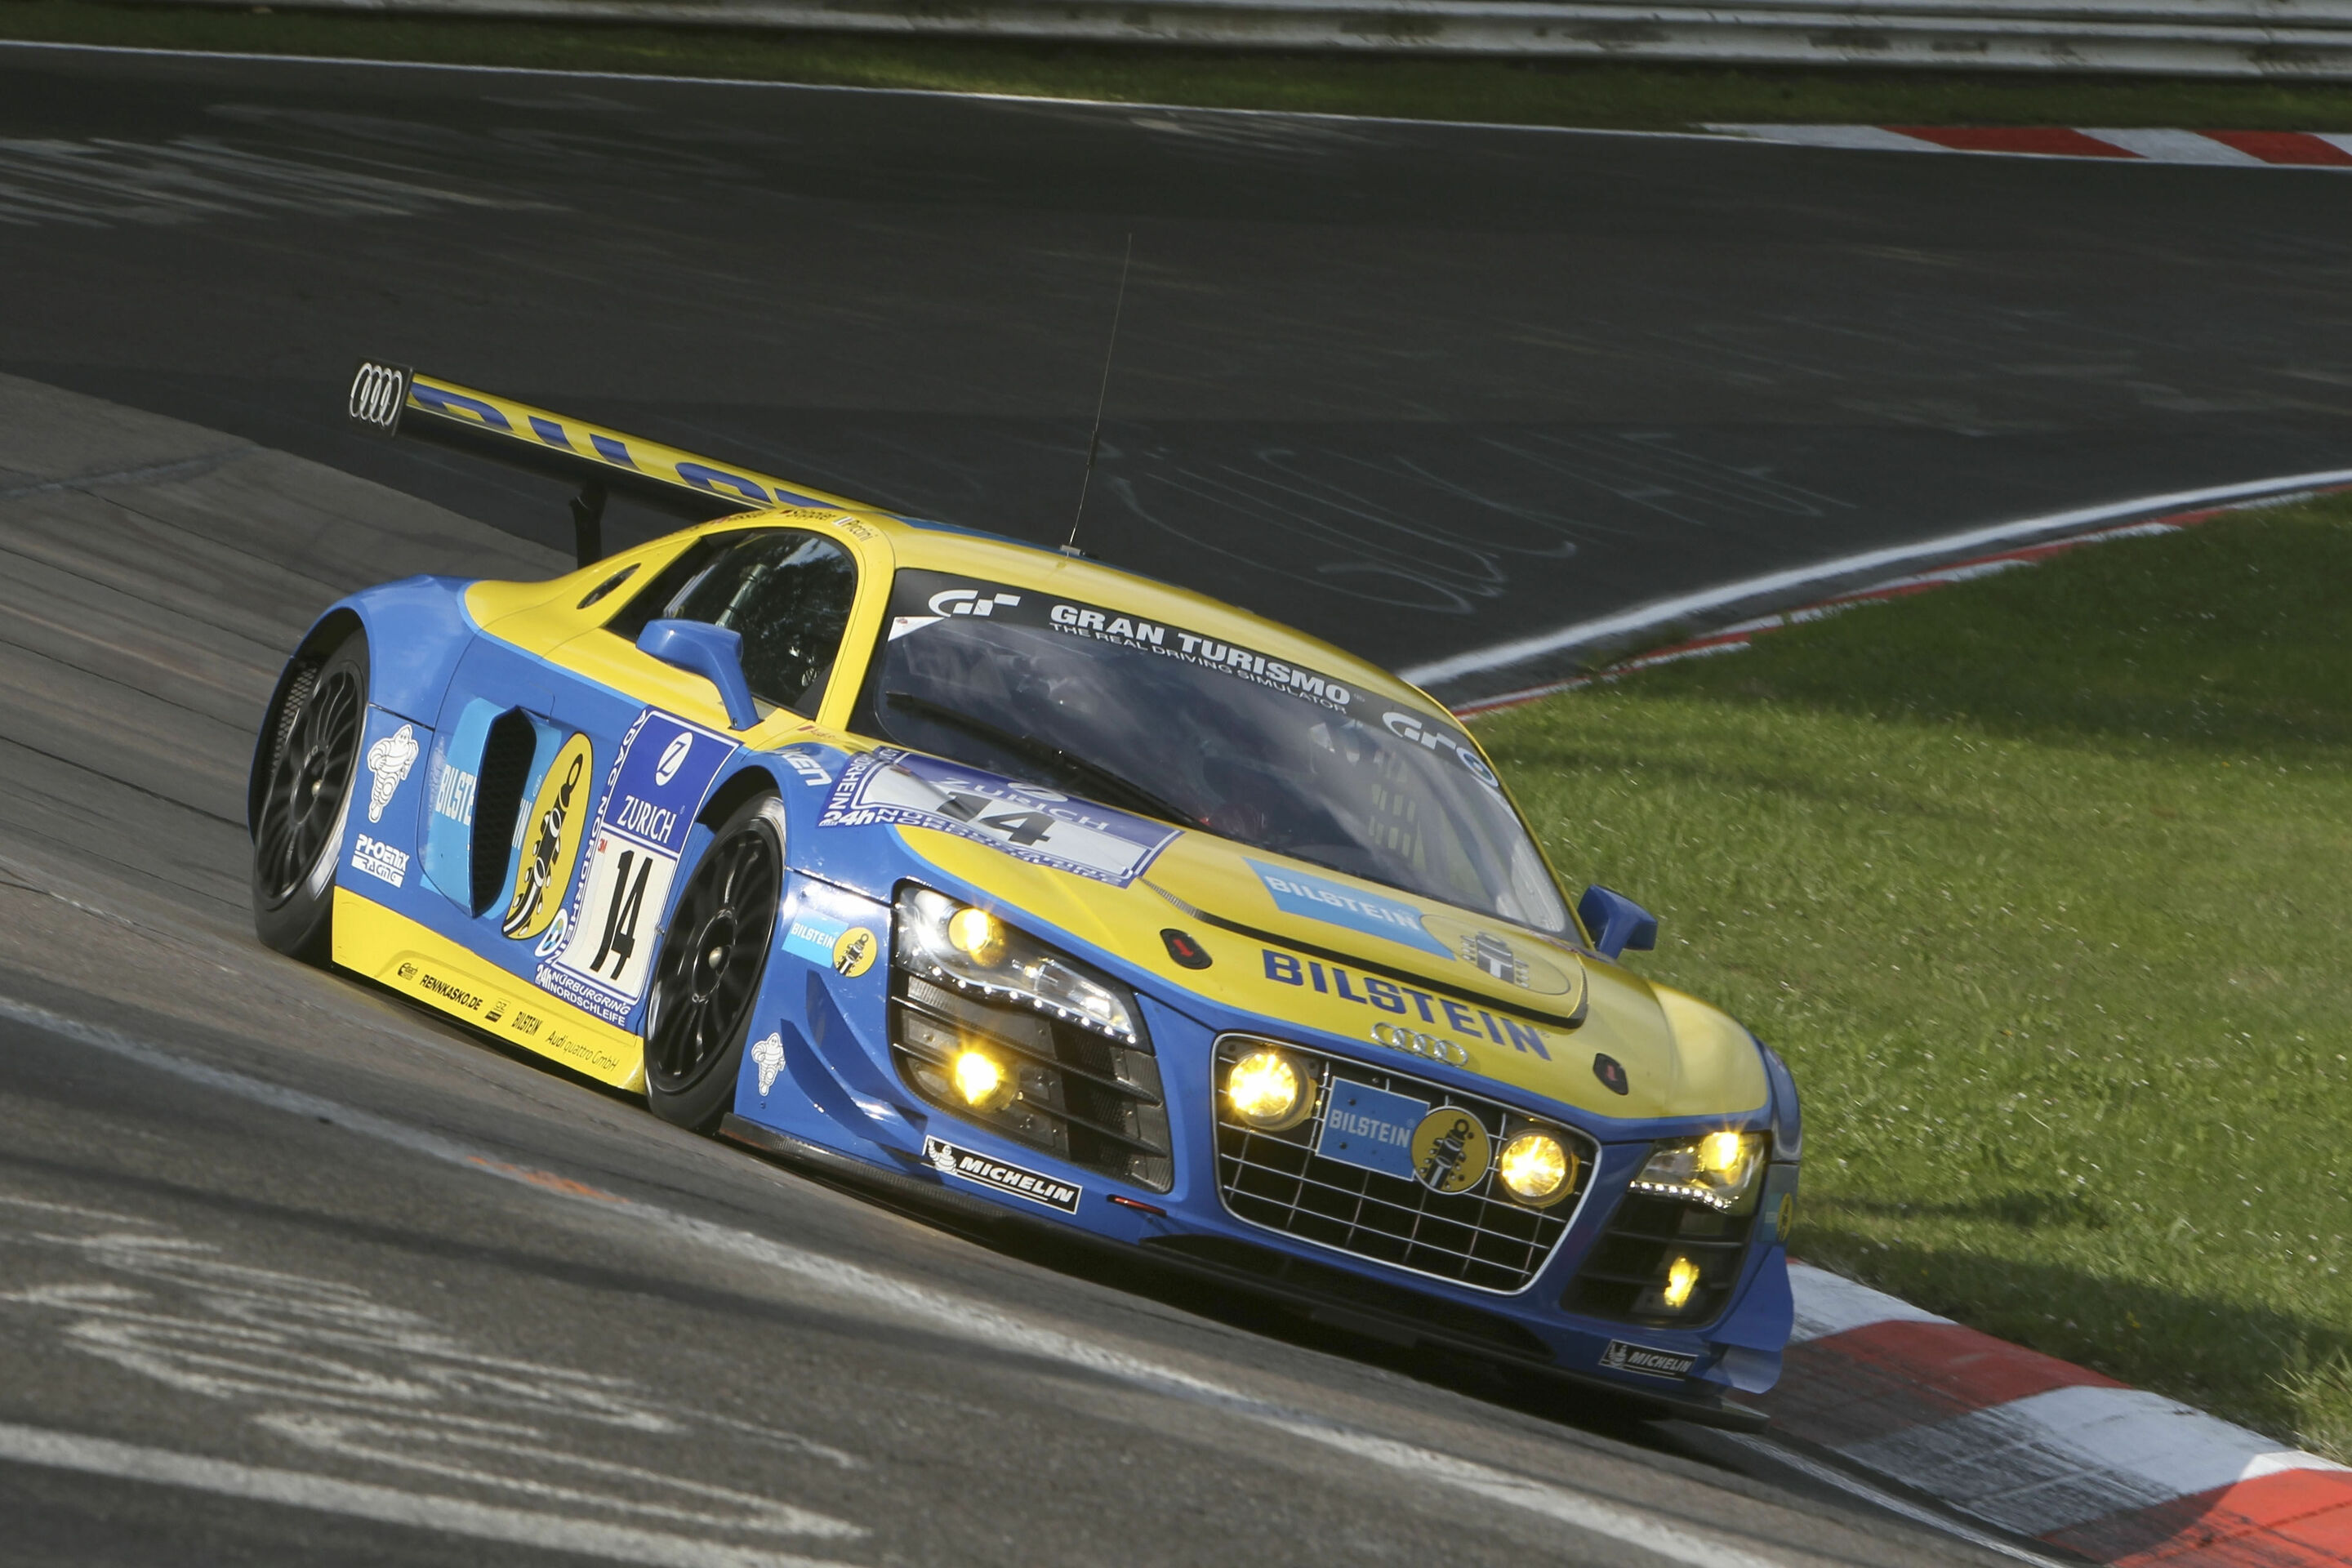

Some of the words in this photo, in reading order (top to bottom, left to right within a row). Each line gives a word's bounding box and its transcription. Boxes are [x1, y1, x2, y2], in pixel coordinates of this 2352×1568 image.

[1049, 621, 1090, 638] THE
[1096, 631, 1147, 651] REAL
[1152, 645, 1232, 675] DRIVING
[1237, 669, 1346, 714] SIMULATOR
[1050, 604, 1165, 645] GRAN
[1178, 632, 1350, 706] TURISMO
[608, 709, 646, 786] ADAC
[617, 795, 677, 844] ZURICH
[818, 809, 875, 826] 24h
[937, 791, 1058, 846] 14
[938, 777, 1111, 831] ZURICH
[589, 850, 653, 981] 14
[1265, 875, 1420, 931] BILSTEIN
[790, 921, 836, 950] BILSTEIN
[419, 974, 483, 1011] RENNKASKO.DE
[550, 982, 626, 1027] NORDSCHLEIFE
[551, 970, 631, 1016] NÜRBURGRING
[1262, 949, 1552, 1062] BILSTEIN
[511, 1011, 543, 1037] BILSTEIN
[545, 1030, 567, 1049] Audi
[564, 1038, 595, 1061] quattro
[592, 1050, 621, 1071] GmbH
[1329, 1108, 1411, 1148] BILSTEIN
[959, 1156, 1076, 1203] MICHELIN
[1627, 1352, 1693, 1373] MICHELIN
